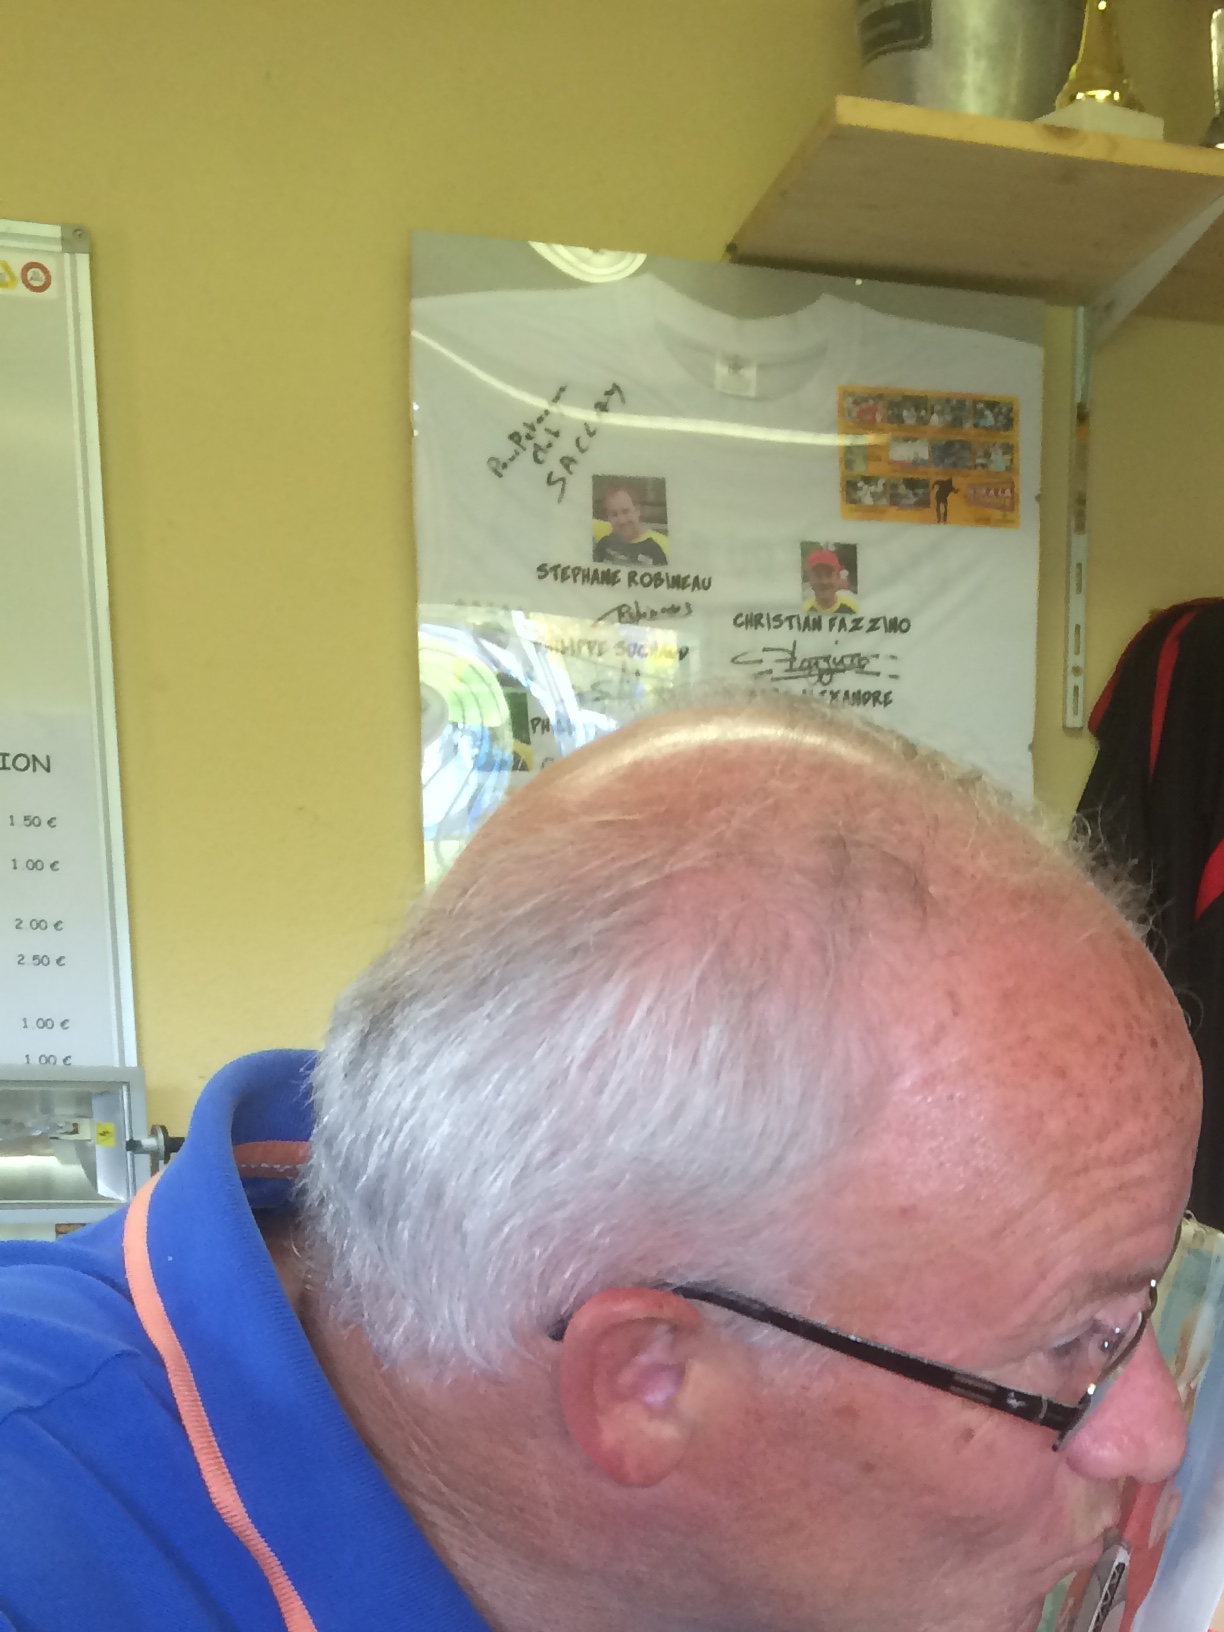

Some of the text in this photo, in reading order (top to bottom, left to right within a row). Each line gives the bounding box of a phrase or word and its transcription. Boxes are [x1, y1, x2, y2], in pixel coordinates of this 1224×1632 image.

[536, 562, 712, 592] STEPHANE ROBINEAU
[732, 612, 912, 634] CHRISTIAN FAZZINO
[801, 688, 893, 708] XANDRE
